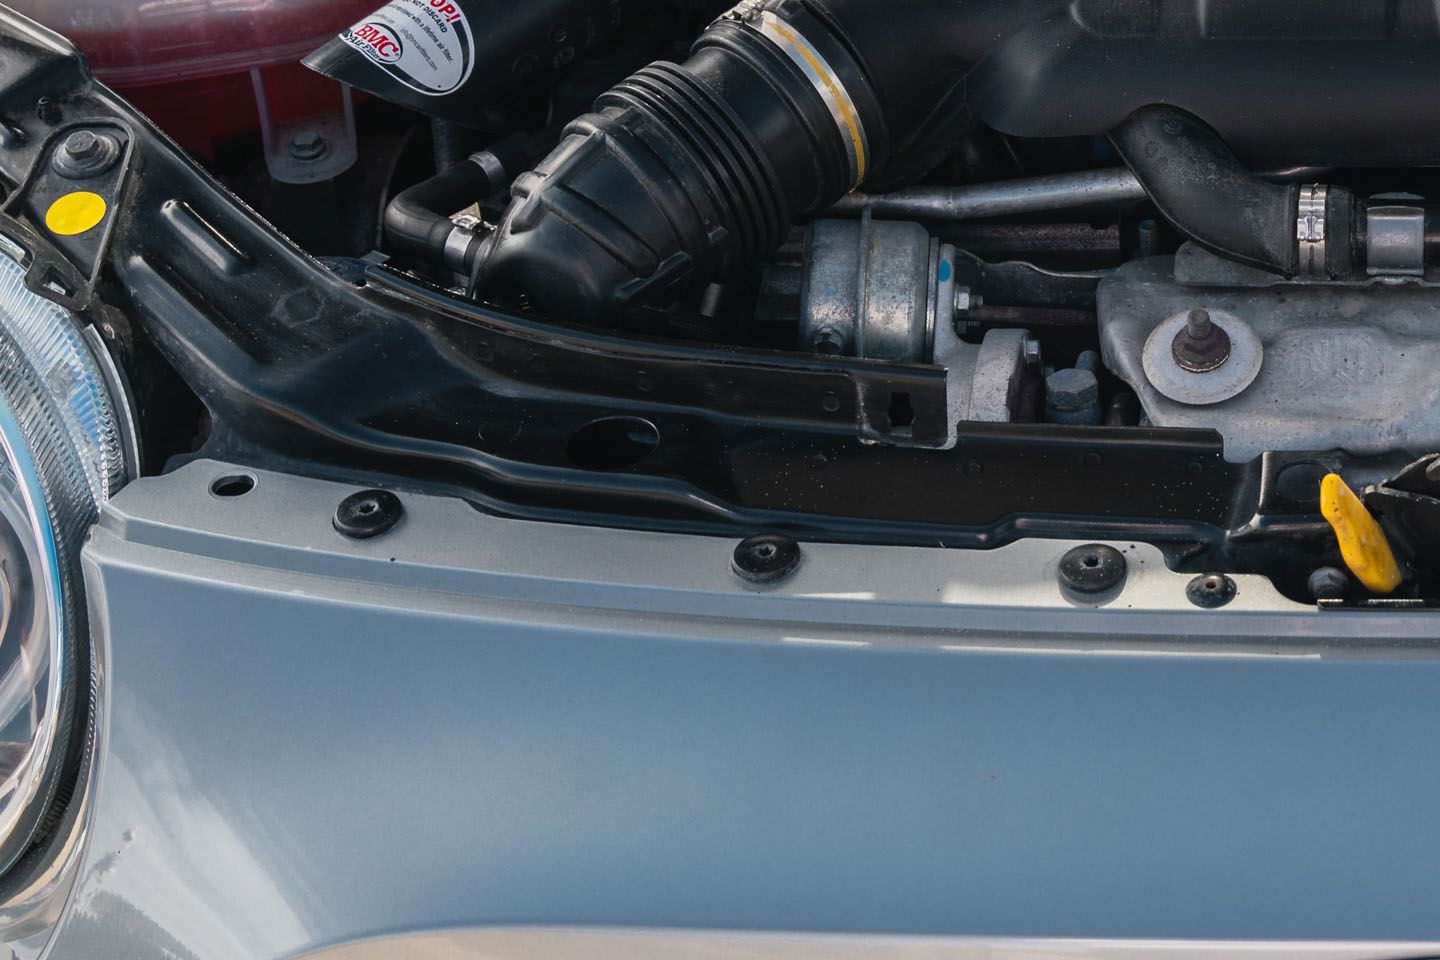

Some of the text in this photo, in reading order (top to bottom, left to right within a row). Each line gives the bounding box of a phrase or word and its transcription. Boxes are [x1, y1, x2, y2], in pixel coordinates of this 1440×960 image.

[411, 0, 425, 8] NOT
[423, 6, 448, 33] DISCARD
[354, 23, 399, 57] BMC
[422, 25, 439, 43] lifetime
